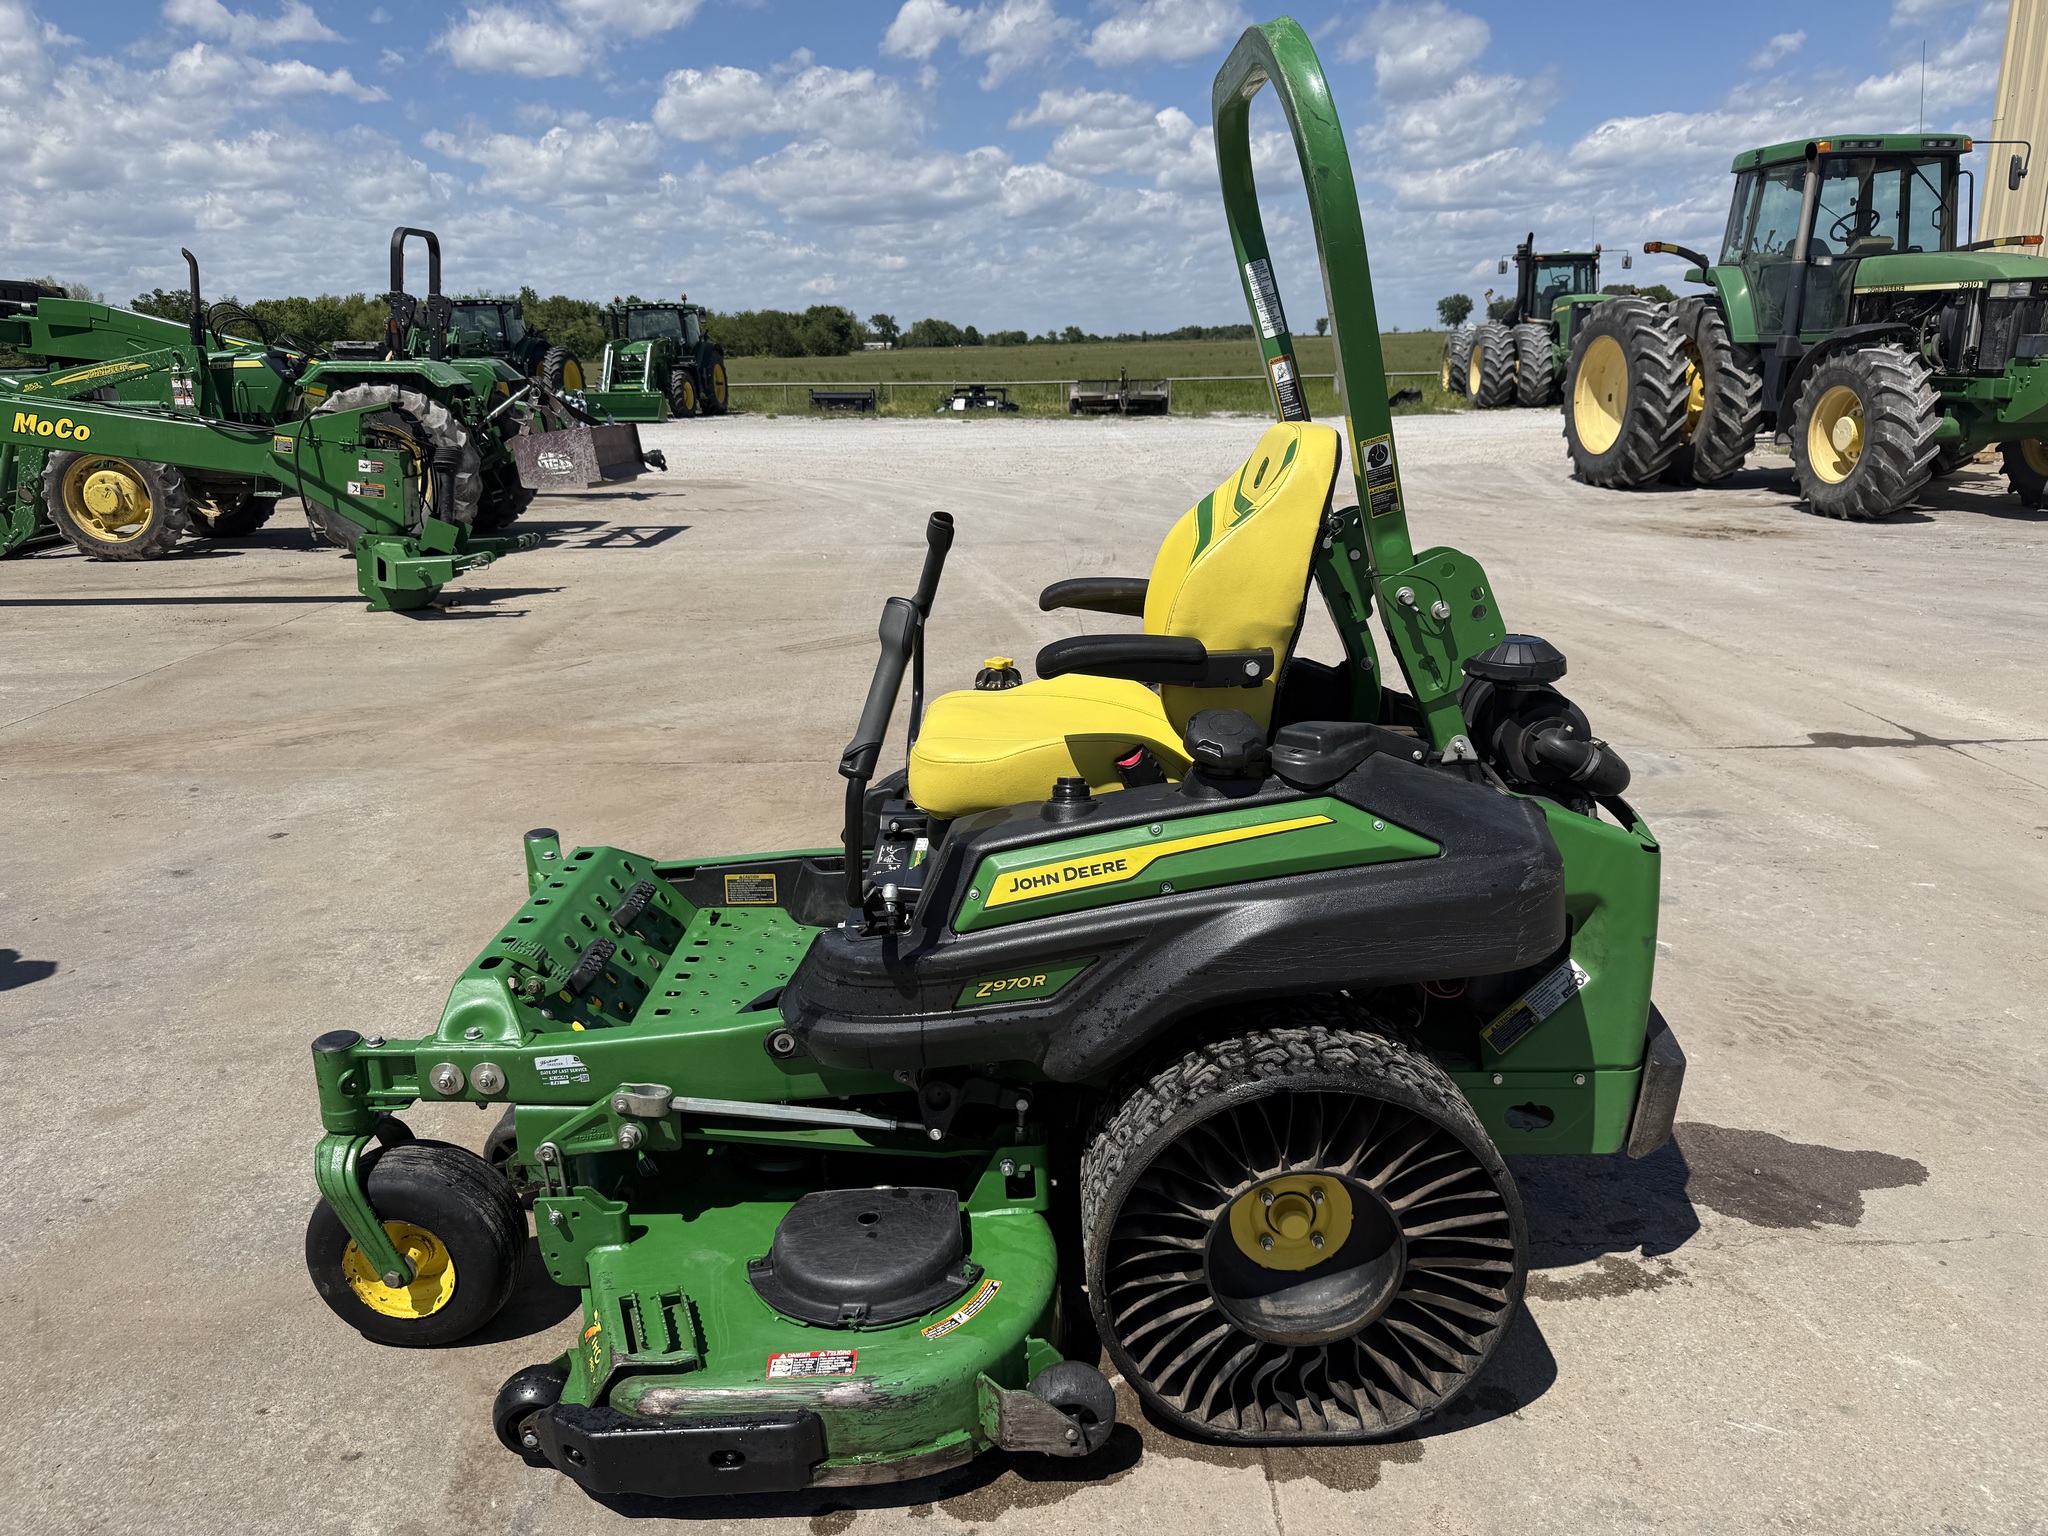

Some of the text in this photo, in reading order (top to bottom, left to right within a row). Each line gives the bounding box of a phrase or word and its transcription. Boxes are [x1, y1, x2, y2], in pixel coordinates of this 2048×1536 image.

[1959, 281, 1979, 289] 7810
[13, 412, 91, 441] MoCo
[1367, 435, 1388, 445] CAUTION
[1009, 858, 1128, 893] JOHN DEERE
